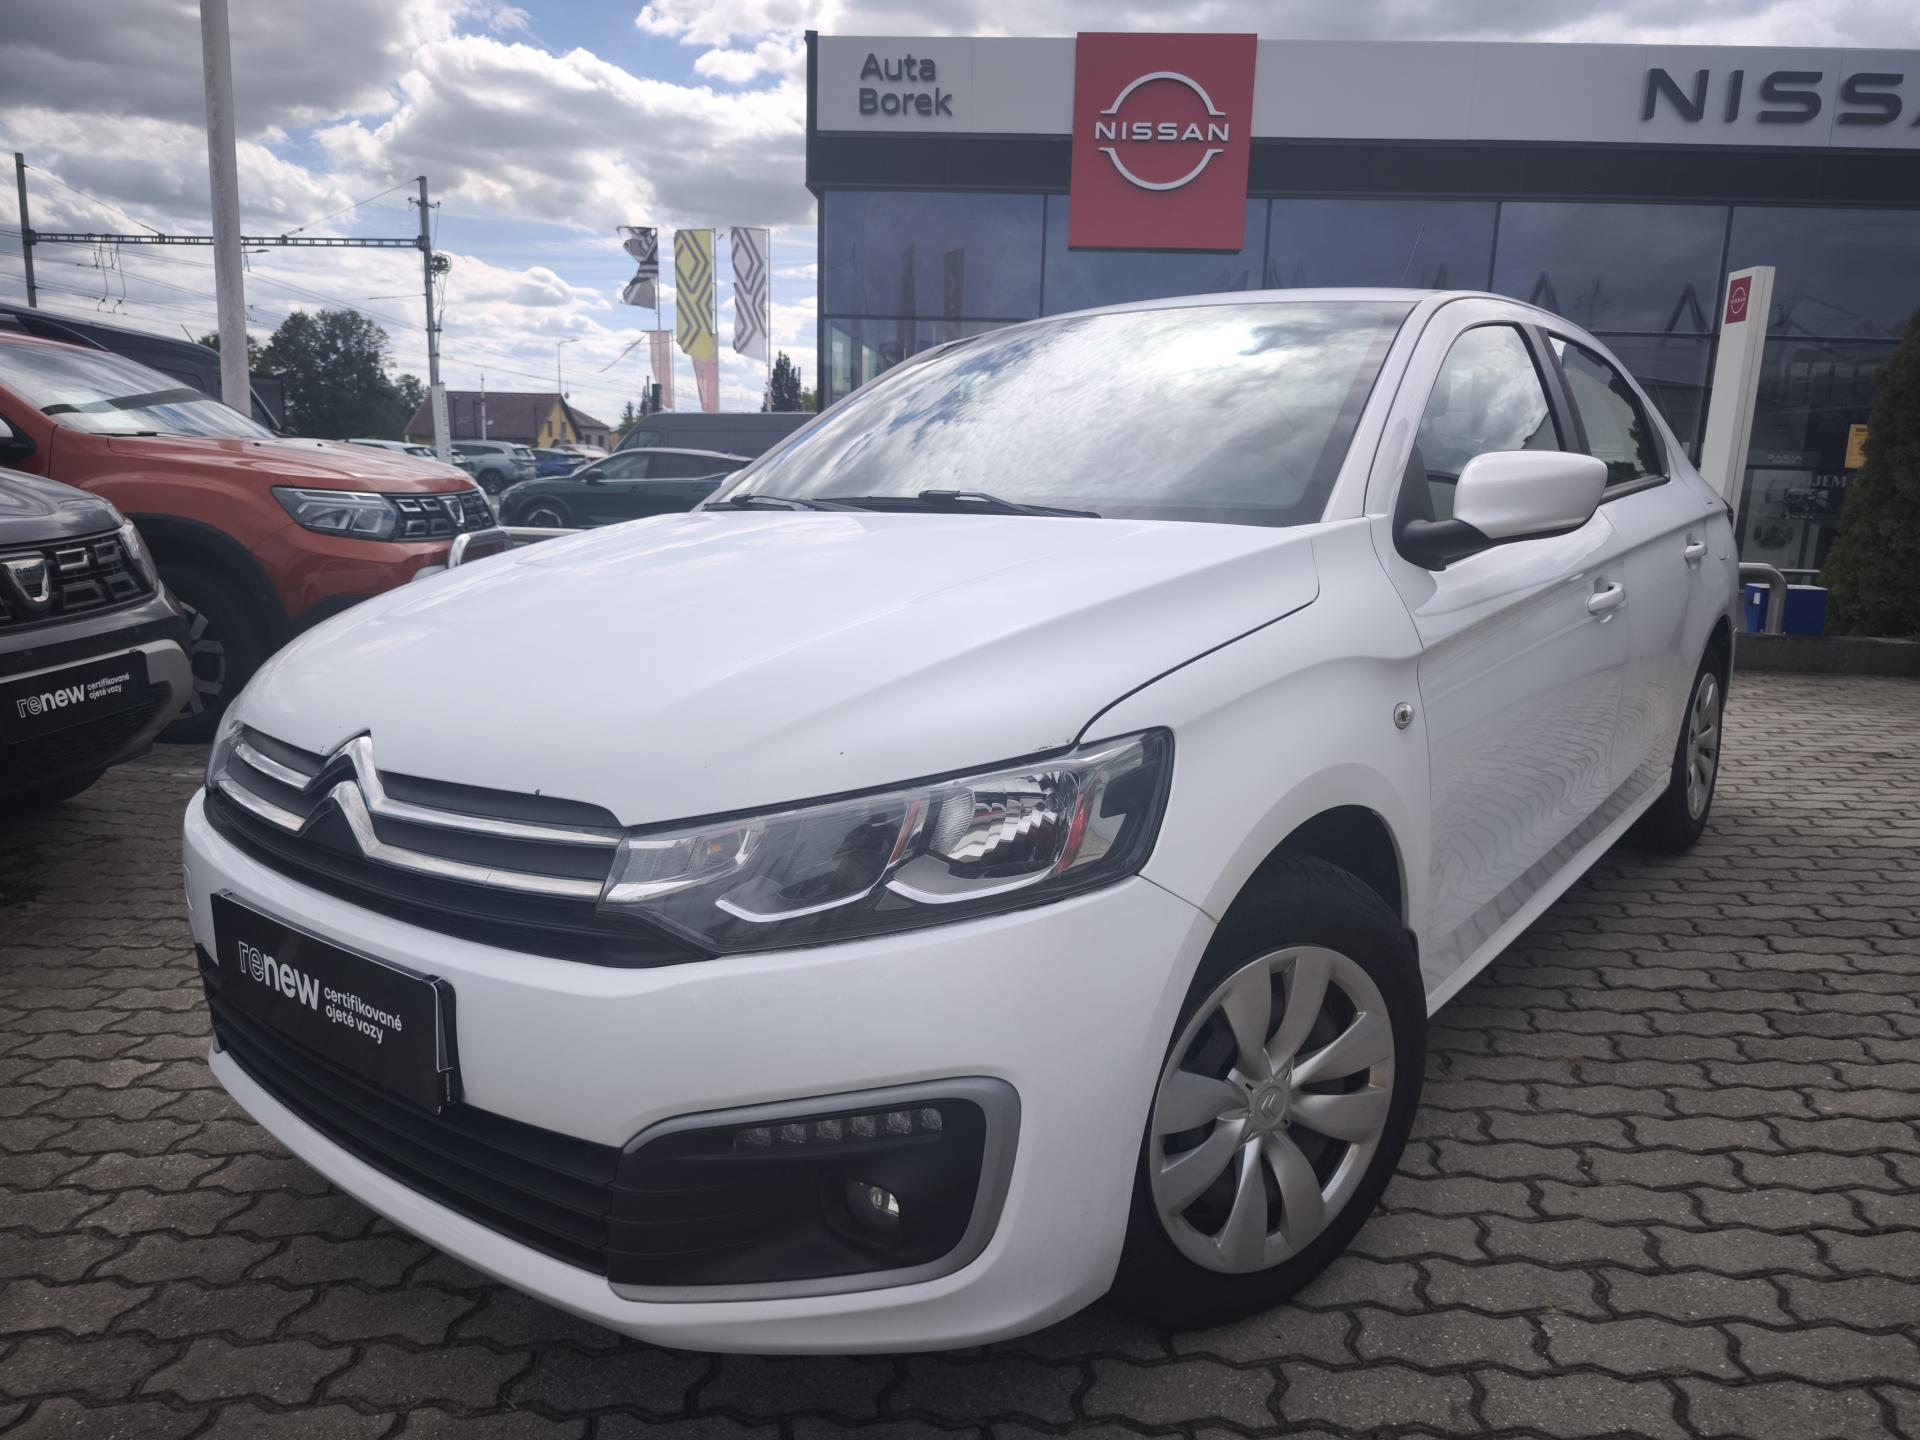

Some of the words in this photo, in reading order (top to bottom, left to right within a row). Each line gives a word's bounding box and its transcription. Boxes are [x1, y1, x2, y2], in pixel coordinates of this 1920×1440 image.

[860, 53, 937, 81] Auta
[859, 87, 953, 116] Borek
[1641, 68, 1920, 126] NISS
[1095, 121, 1229, 141] NISSAN
[16, 684, 85, 718] renew
[87, 672, 130, 690] certifikované
[107, 684, 122, 696] vozy
[238, 940, 320, 1010] renew
[324, 986, 402, 1031] certifikované
[326, 1004, 354, 1028] ojeté
[356, 1018, 384, 1044] vozy
